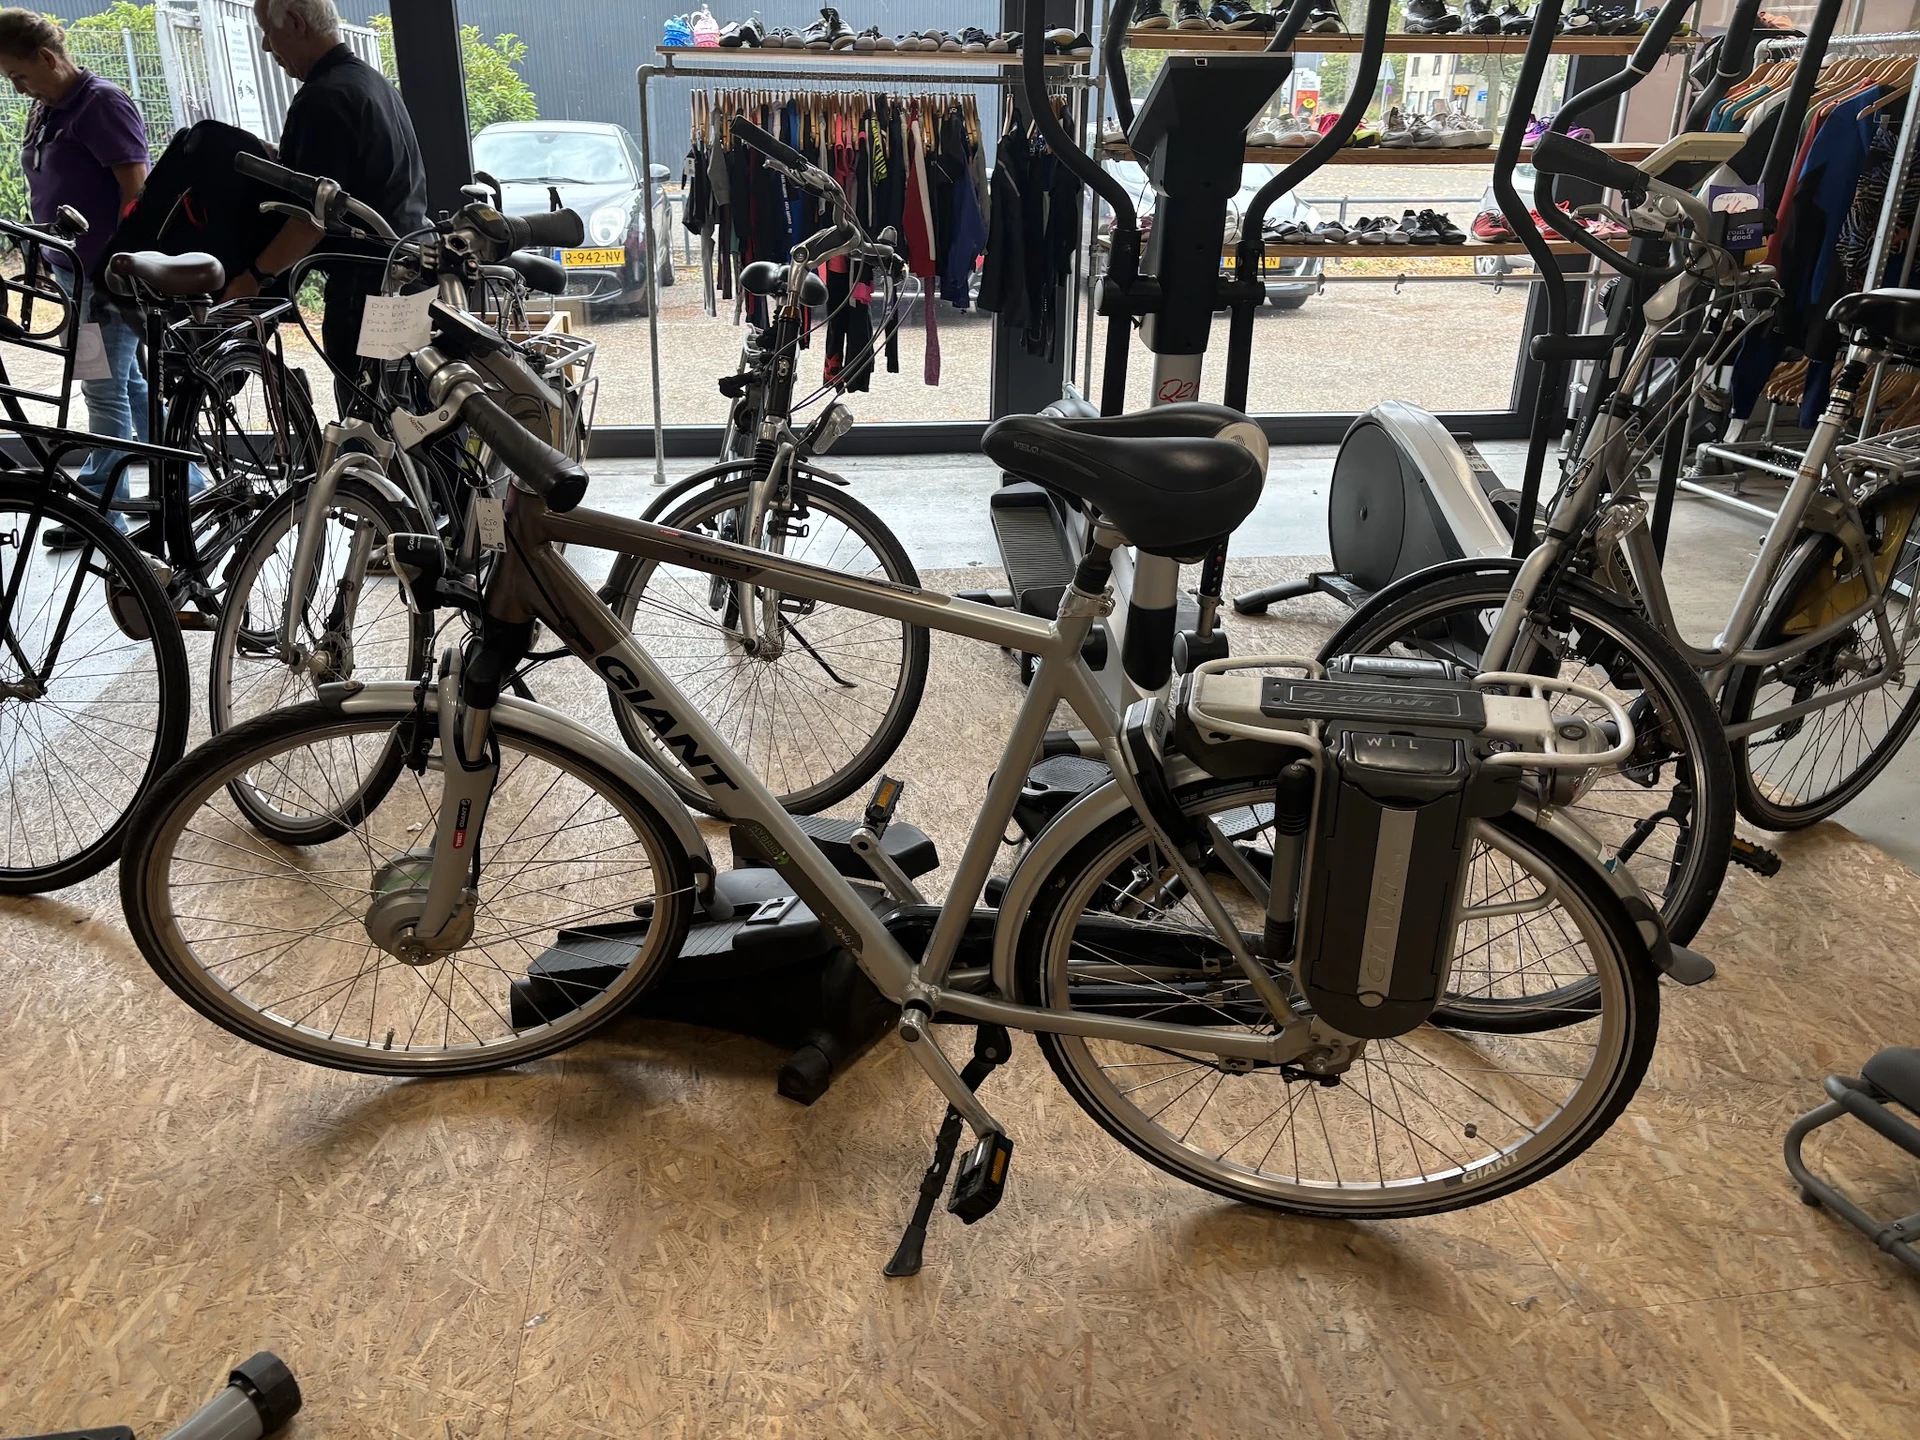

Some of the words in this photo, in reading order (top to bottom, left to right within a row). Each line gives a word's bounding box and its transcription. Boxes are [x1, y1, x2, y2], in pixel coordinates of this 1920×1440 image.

[565, 251, 621, 264] R-942-NV
[1337, 694, 1439, 708] GIANT
[595, 655, 740, 791] GIANT
[751, 824, 780, 856] HYBRID
[1367, 872, 1398, 983] GIANT
[1461, 1150, 1519, 1184] GIANT
